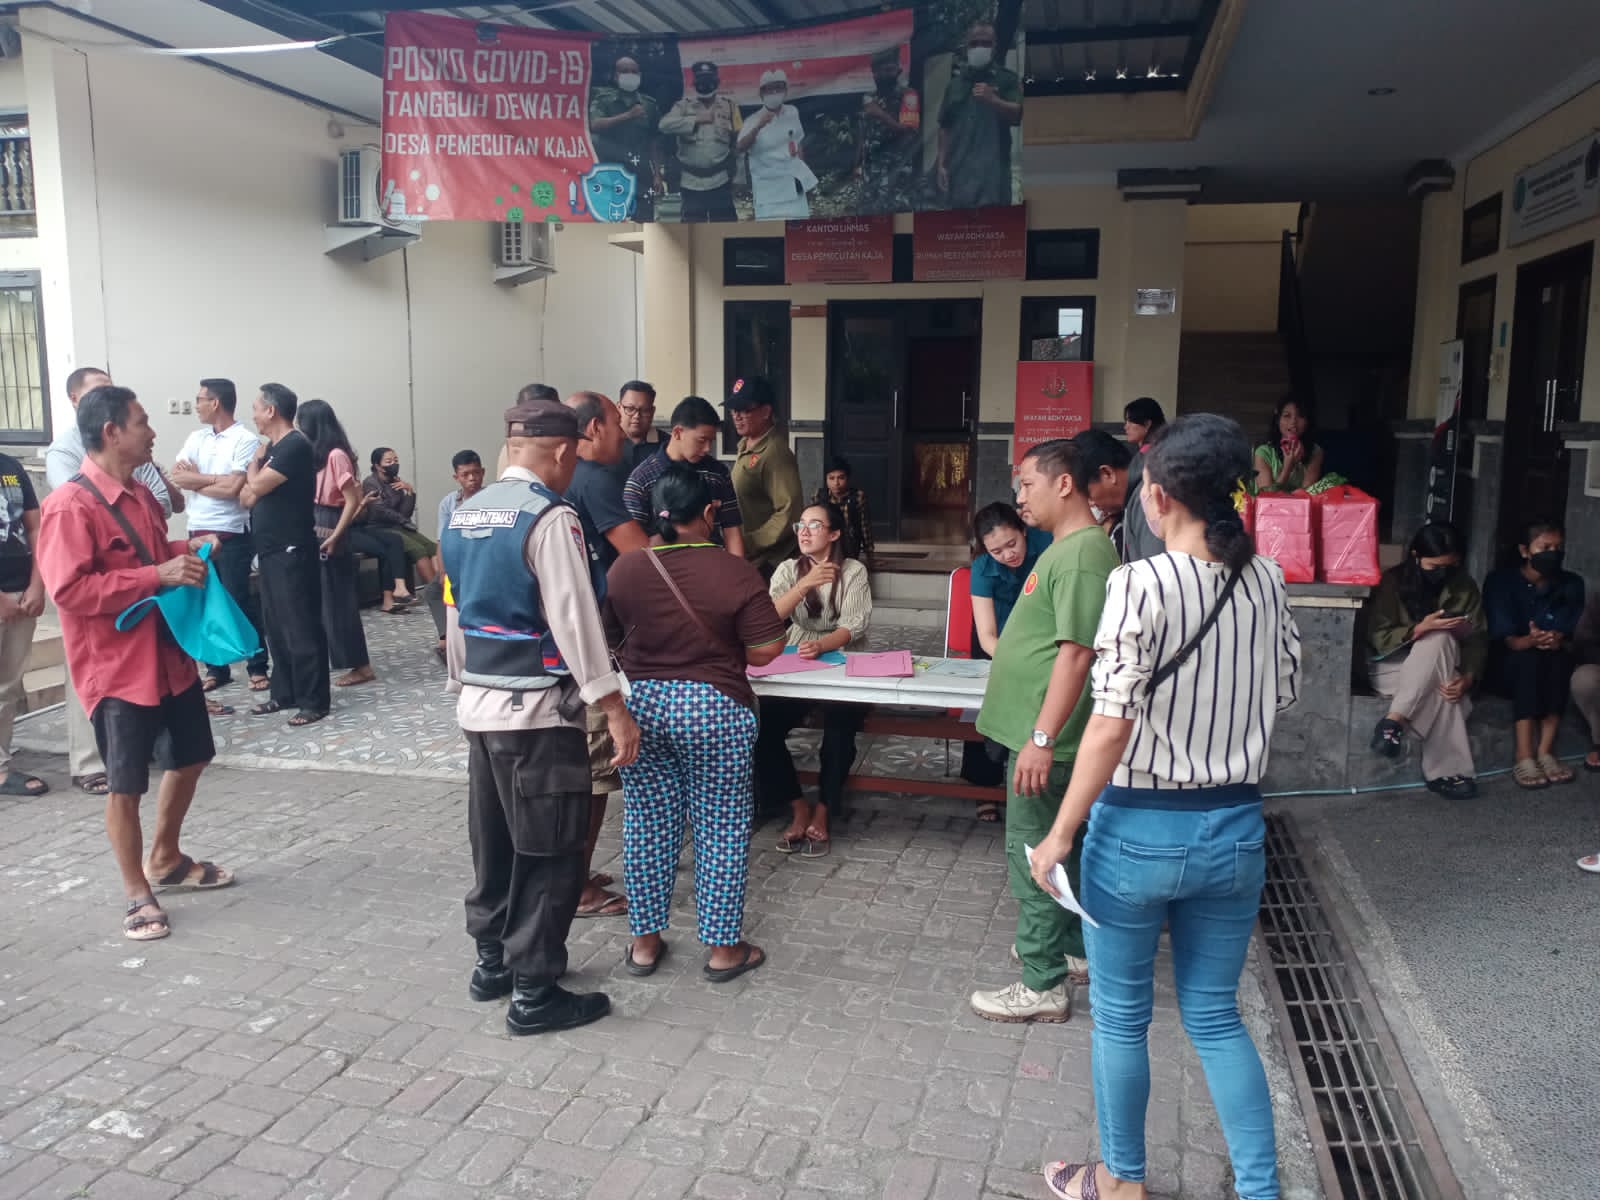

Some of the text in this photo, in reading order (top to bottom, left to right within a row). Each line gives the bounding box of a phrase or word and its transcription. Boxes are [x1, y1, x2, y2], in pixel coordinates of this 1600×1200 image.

[387, 46, 584, 85] POSKO COVID-19
[386, 91, 581, 120] TANGGUH DEWATA
[385, 133, 589, 158] DESA PEMECUTAN KAJA
